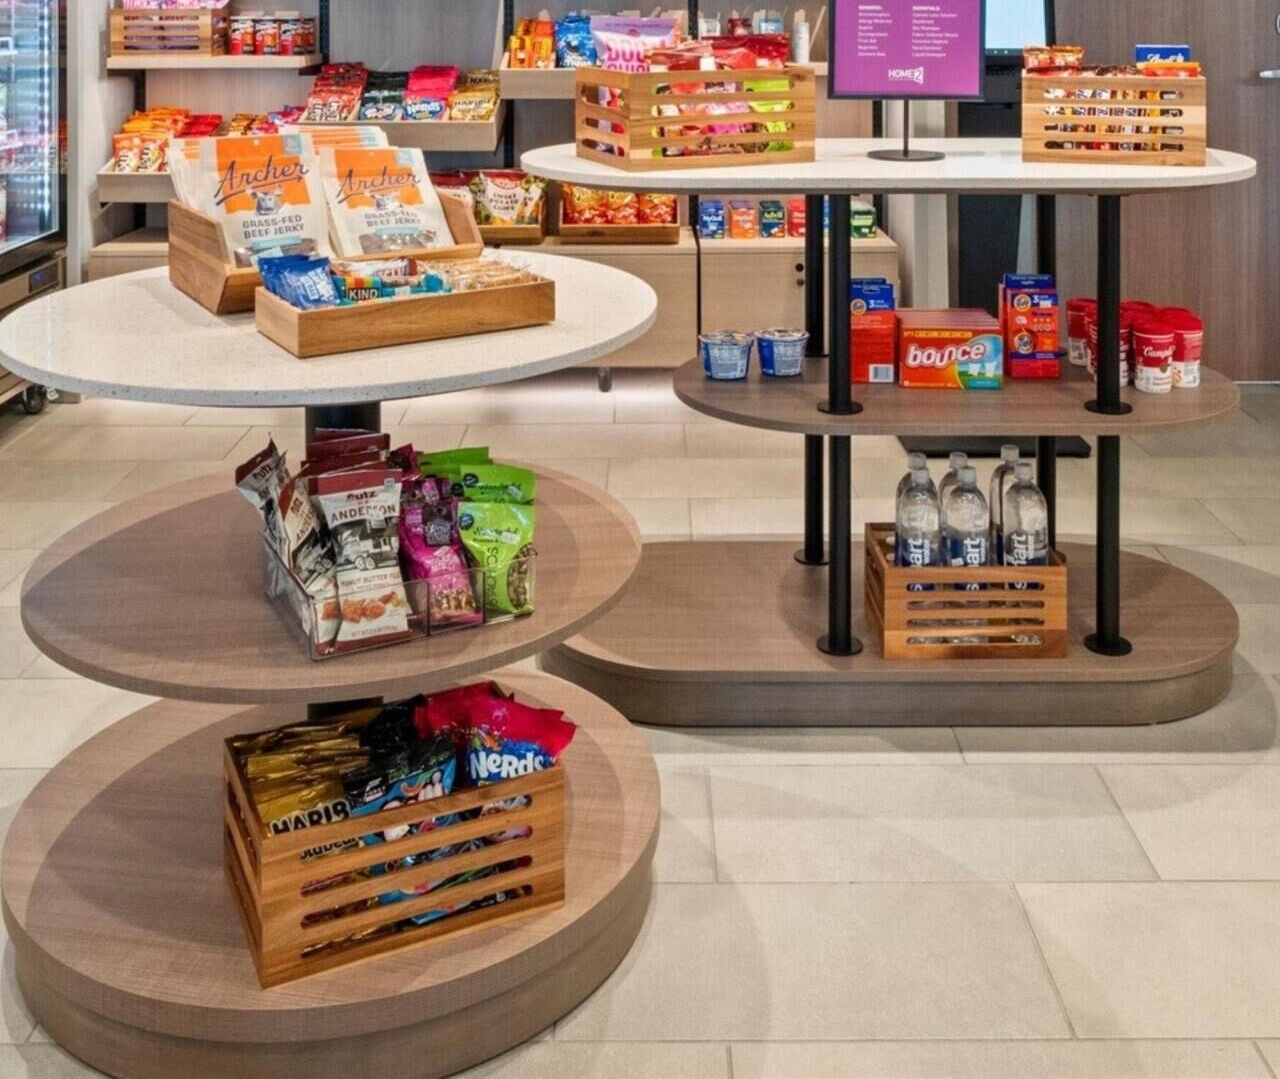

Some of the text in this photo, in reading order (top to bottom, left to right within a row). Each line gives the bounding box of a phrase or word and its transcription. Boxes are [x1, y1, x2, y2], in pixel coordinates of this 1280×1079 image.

[214, 154, 310, 199] Archer
[335, 165, 421, 198] Archer
[242, 214, 302, 229] GRASS-FED
[243, 223, 305, 239] BEEF JERKY
[366, 216, 421, 227] BEEF JERKY
[348, 289, 379, 299] KIND
[907, 343, 986, 367] bounce
[270, 800, 351, 835] HARIB
